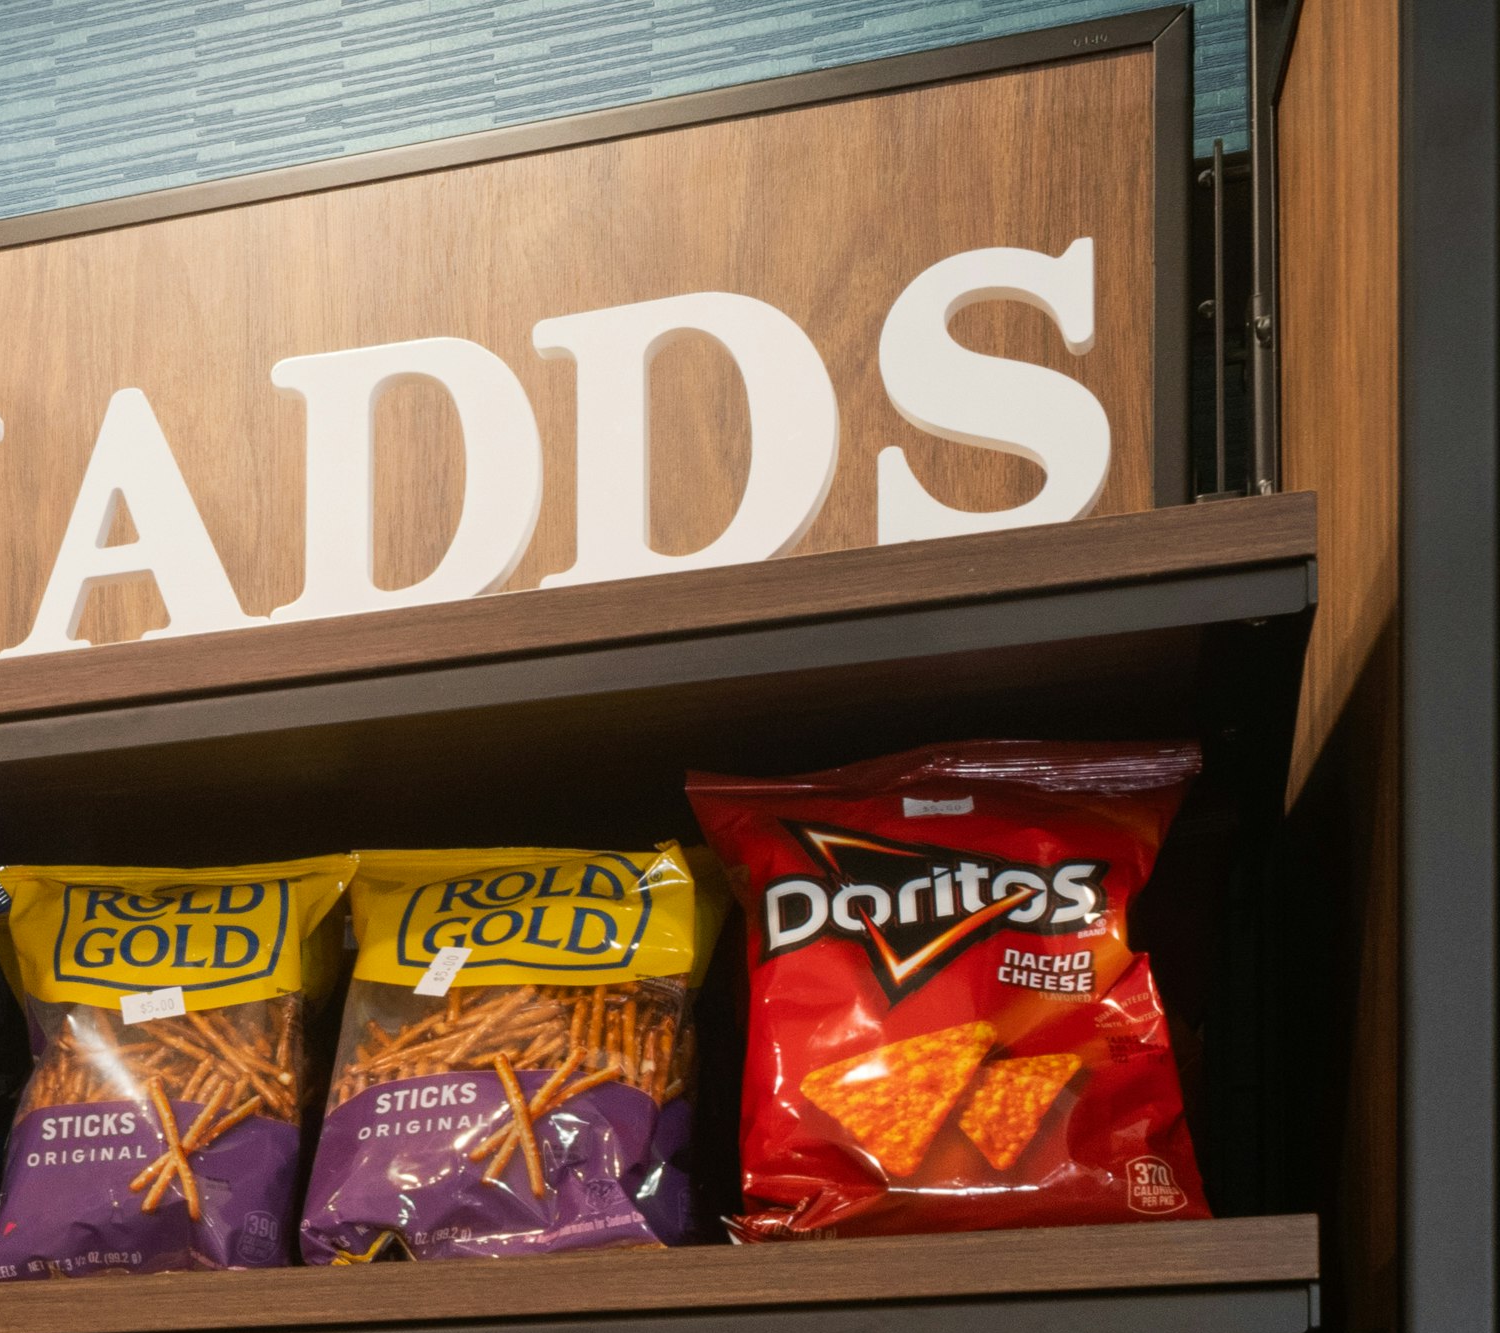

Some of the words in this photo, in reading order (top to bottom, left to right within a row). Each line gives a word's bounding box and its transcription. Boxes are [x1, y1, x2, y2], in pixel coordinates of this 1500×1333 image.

[439, 855, 626, 912] ROLD
[83, 883, 266, 923] ROLD
[766, 861, 1101, 951] Doritos
[73, 922, 261, 969] GOLD
[422, 908, 619, 956] GOLD
[1005, 949, 1092, 971] NACHO
[998, 966, 1093, 992] CHEESE
[375, 1082, 478, 1114] STICKS
[41, 1111, 137, 1141] STICKS
[358, 1112, 489, 1141] ORIGINAL
[26, 1146, 148, 1168] ORIGINAL
[1134, 1163, 1167, 1185] 370
